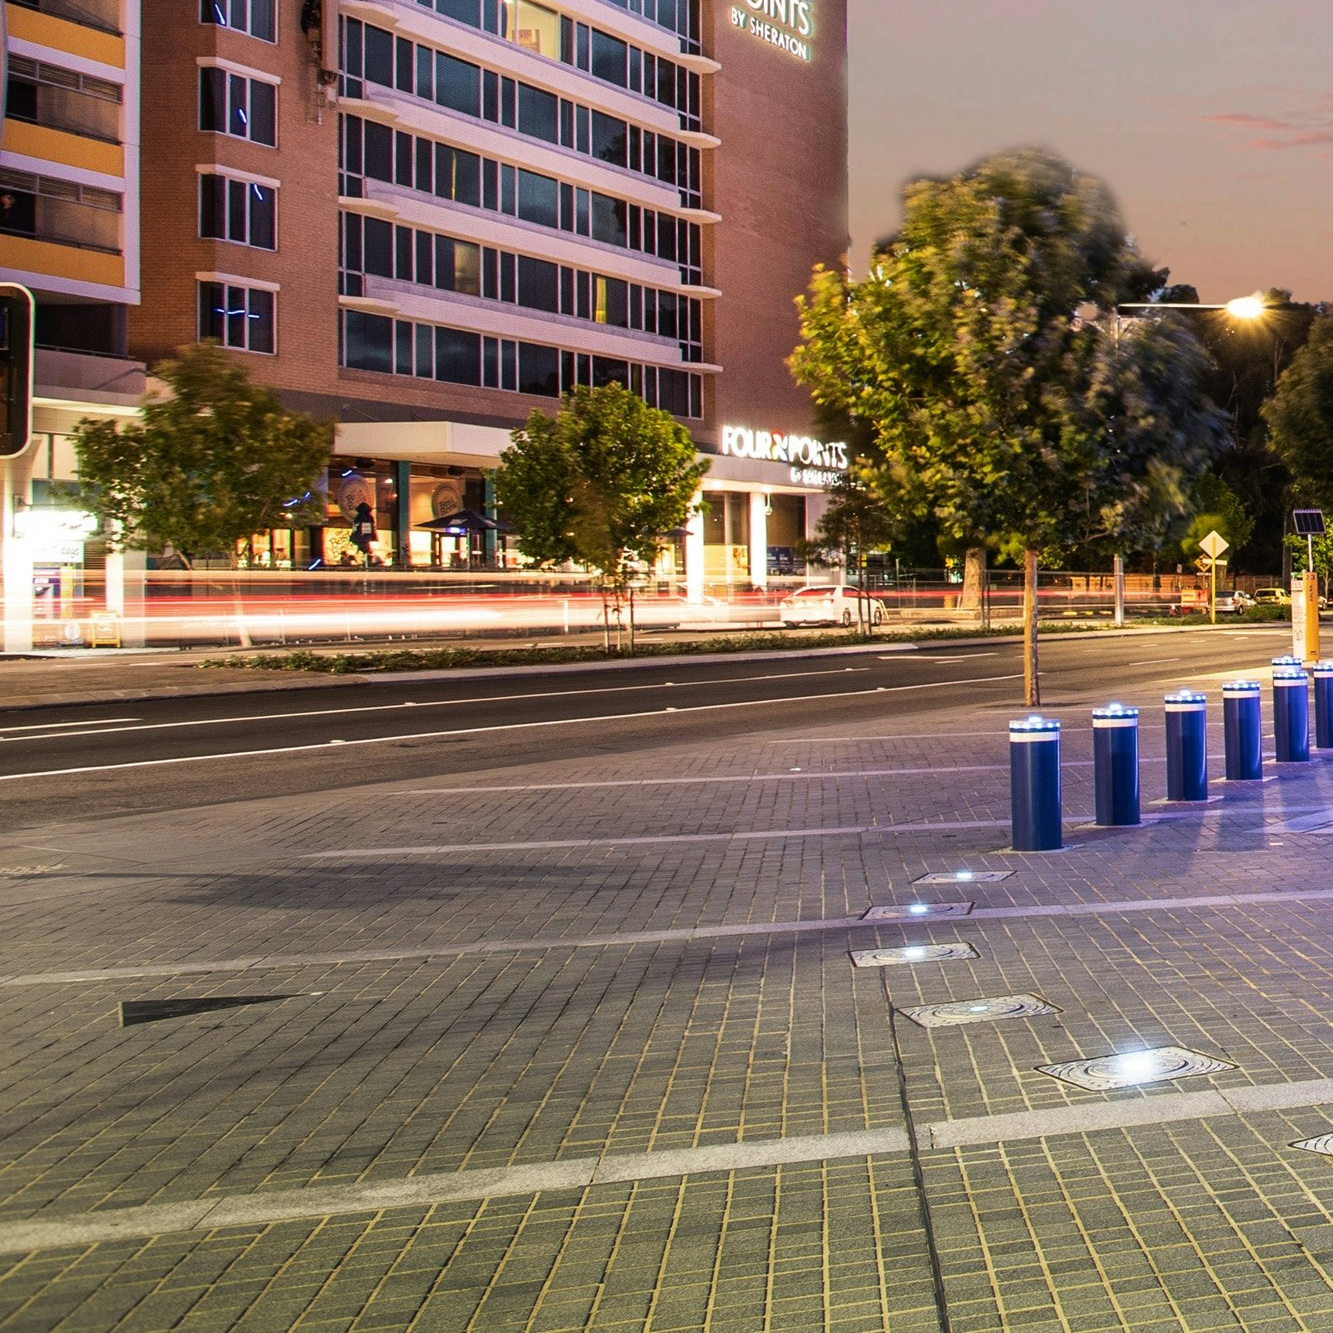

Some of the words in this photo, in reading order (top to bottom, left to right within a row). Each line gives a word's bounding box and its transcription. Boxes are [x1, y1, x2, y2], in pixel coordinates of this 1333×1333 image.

[731, 7, 747, 28] BY
[750, 17, 809, 61] SHERATON
[722, 426, 772, 460] FOUR
[789, 435, 848, 469] POINTS
